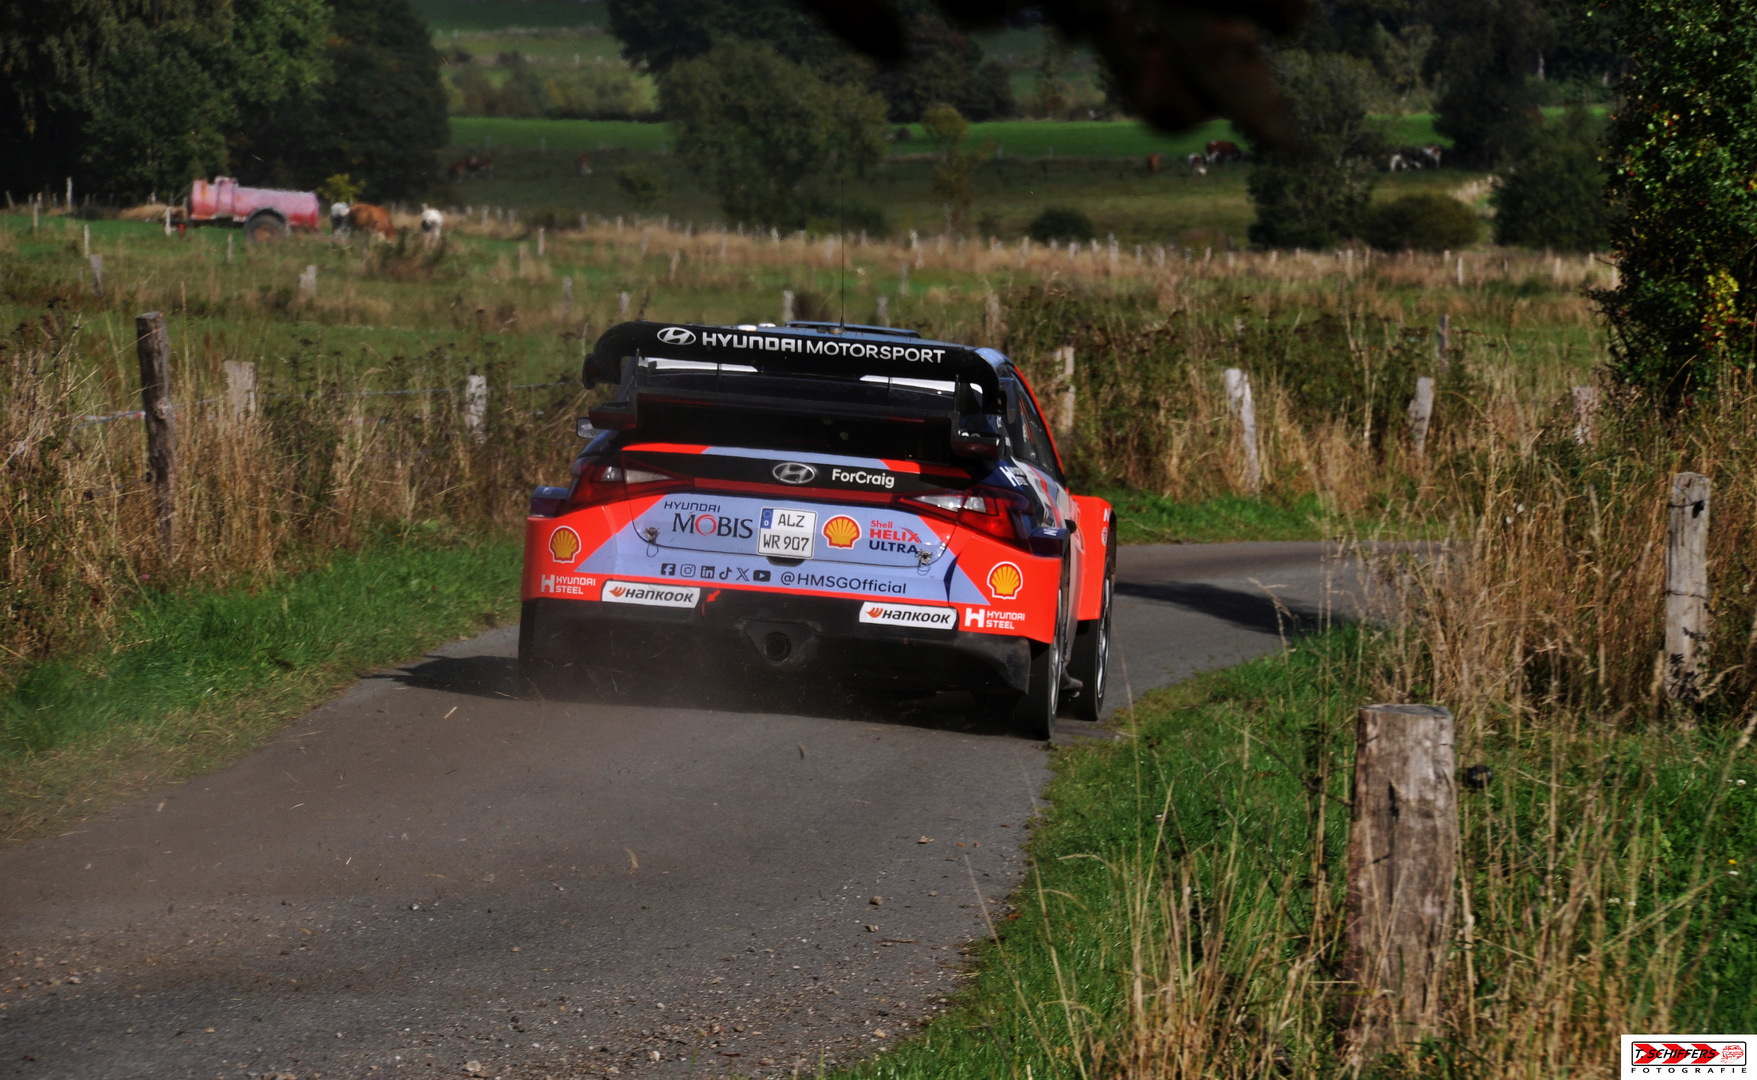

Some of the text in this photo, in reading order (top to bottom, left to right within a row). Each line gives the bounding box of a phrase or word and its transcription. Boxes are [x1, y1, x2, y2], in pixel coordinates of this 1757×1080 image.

[702, 331, 946, 364] HYUNDAI MOTORSPORT
[831, 468, 896, 489] ForCraig
[664, 501, 721, 513] HYUNDAI
[672, 512, 754, 539] MOBIS
[777, 513, 806, 528] ALZ
[870, 520, 894, 529] Shell
[763, 534, 810, 551] WR 907
[869, 527, 922, 544] HELIX
[869, 540, 919, 555] ULTRA
[556, 576, 596, 586] HYUNDAI
[780, 571, 907, 594] @HMSGOfficial
[555, 585, 584, 595] STEEL
[986, 610, 1026, 621] HYUNDAI
[986, 619, 1015, 630] STEEL
